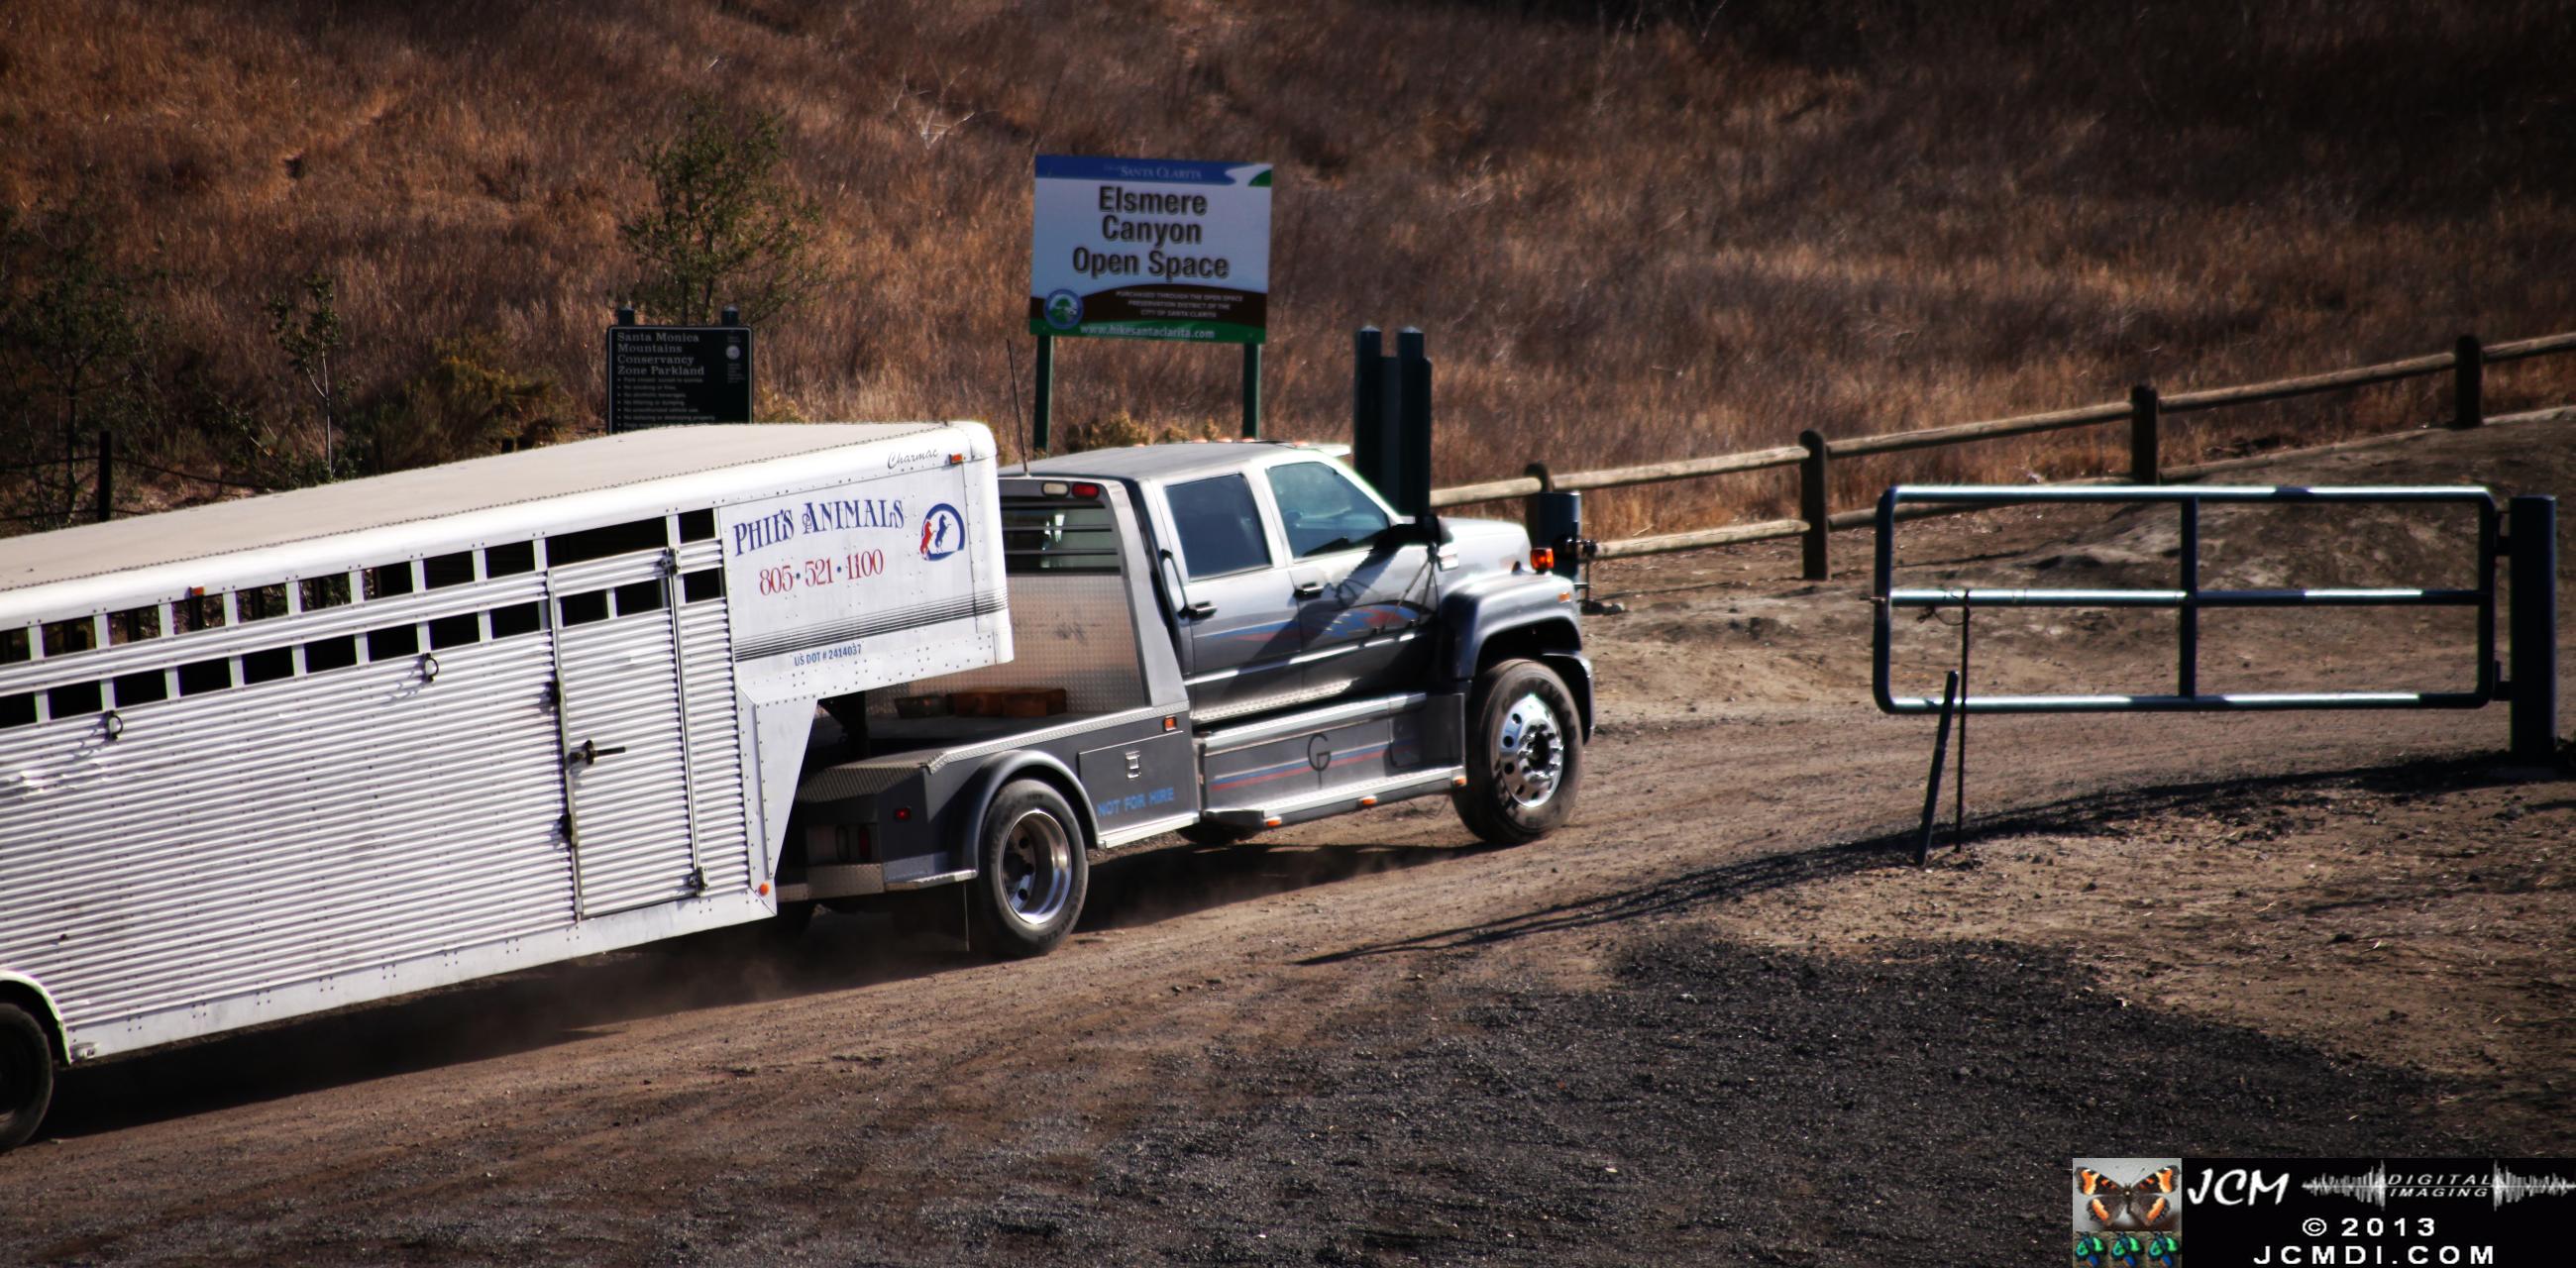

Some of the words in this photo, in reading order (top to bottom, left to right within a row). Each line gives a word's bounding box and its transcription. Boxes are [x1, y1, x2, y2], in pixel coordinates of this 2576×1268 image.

[1099, 185, 1207, 216] Elsmere
[1102, 215, 1202, 247] Canyon
[1072, 247, 1139, 279] Open
[1148, 250, 1230, 282] Space
[617, 332, 652, 342] Santa
[656, 332, 699, 343] Monica
[1079, 324, 1215, 339] www.hikesantaclarita.com
[617, 343, 683, 353] Mountains
[617, 354, 695, 367] Conservancy
[617, 366, 647, 375] Zone
[651, 366, 704, 375] Parkland
[887, 448, 939, 470] Charmac
[803, 499, 905, 535] ANIMALS
[794, 654, 805, 667] US
[805, 651, 821, 665] DOT
[1097, 797, 1122, 816] NOT
[1124, 792, 1146, 811] FOR
[1149, 788, 1174, 807] HIRE
